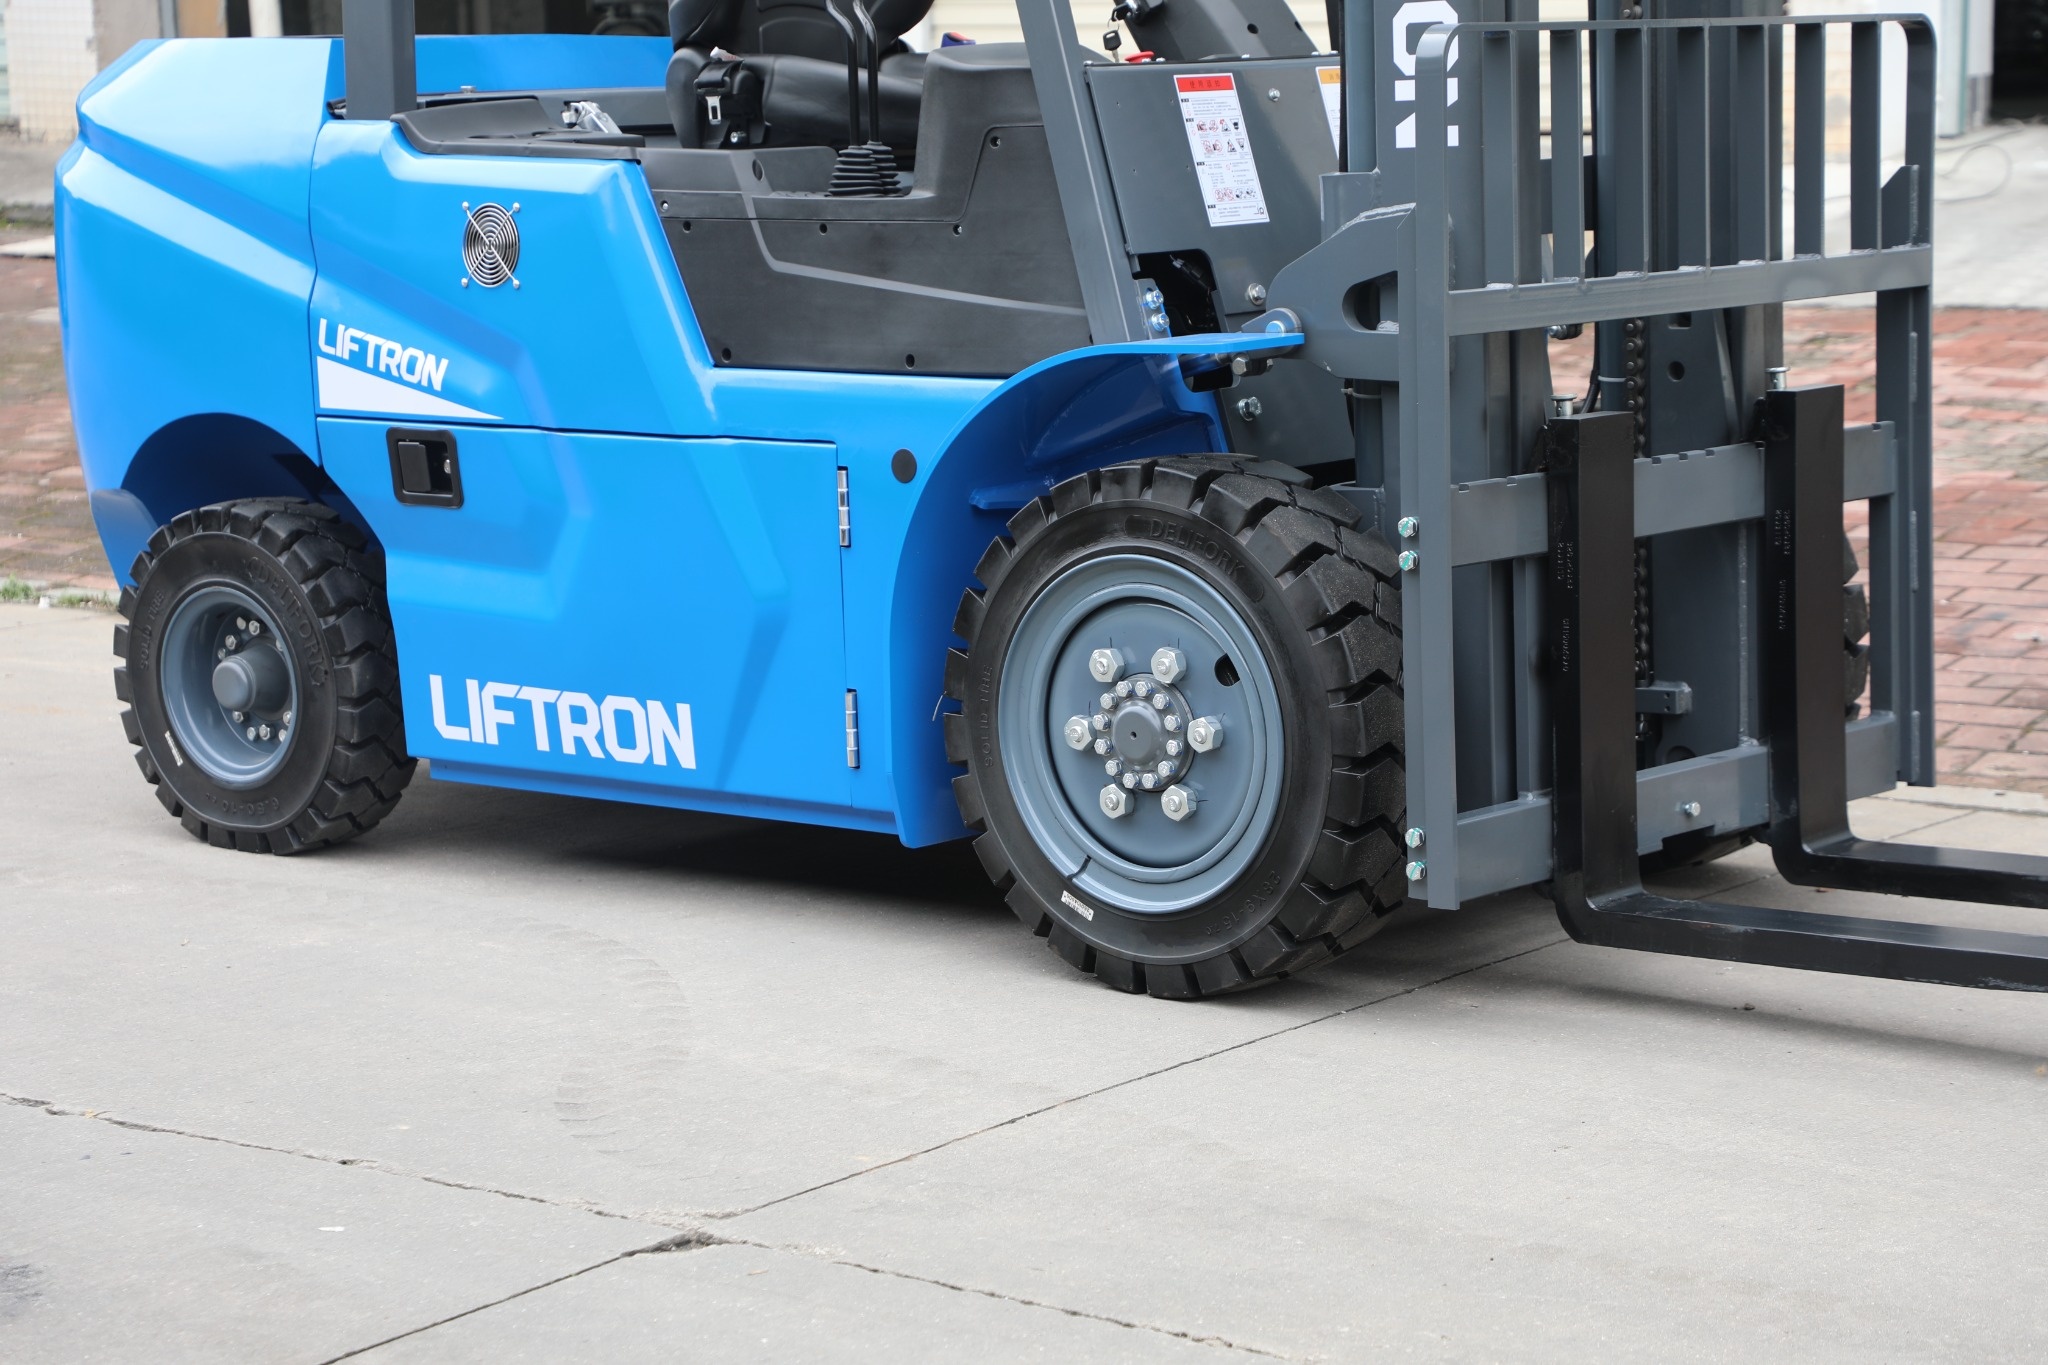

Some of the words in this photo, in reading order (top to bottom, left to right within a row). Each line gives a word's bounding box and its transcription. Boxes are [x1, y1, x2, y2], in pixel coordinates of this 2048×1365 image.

[318, 318, 449, 391] LIFTRON
[1150, 518, 1245, 575] DELIFORK
[429, 674, 696, 770] LIFTRON
[980, 713, 993, 767] SOLID
